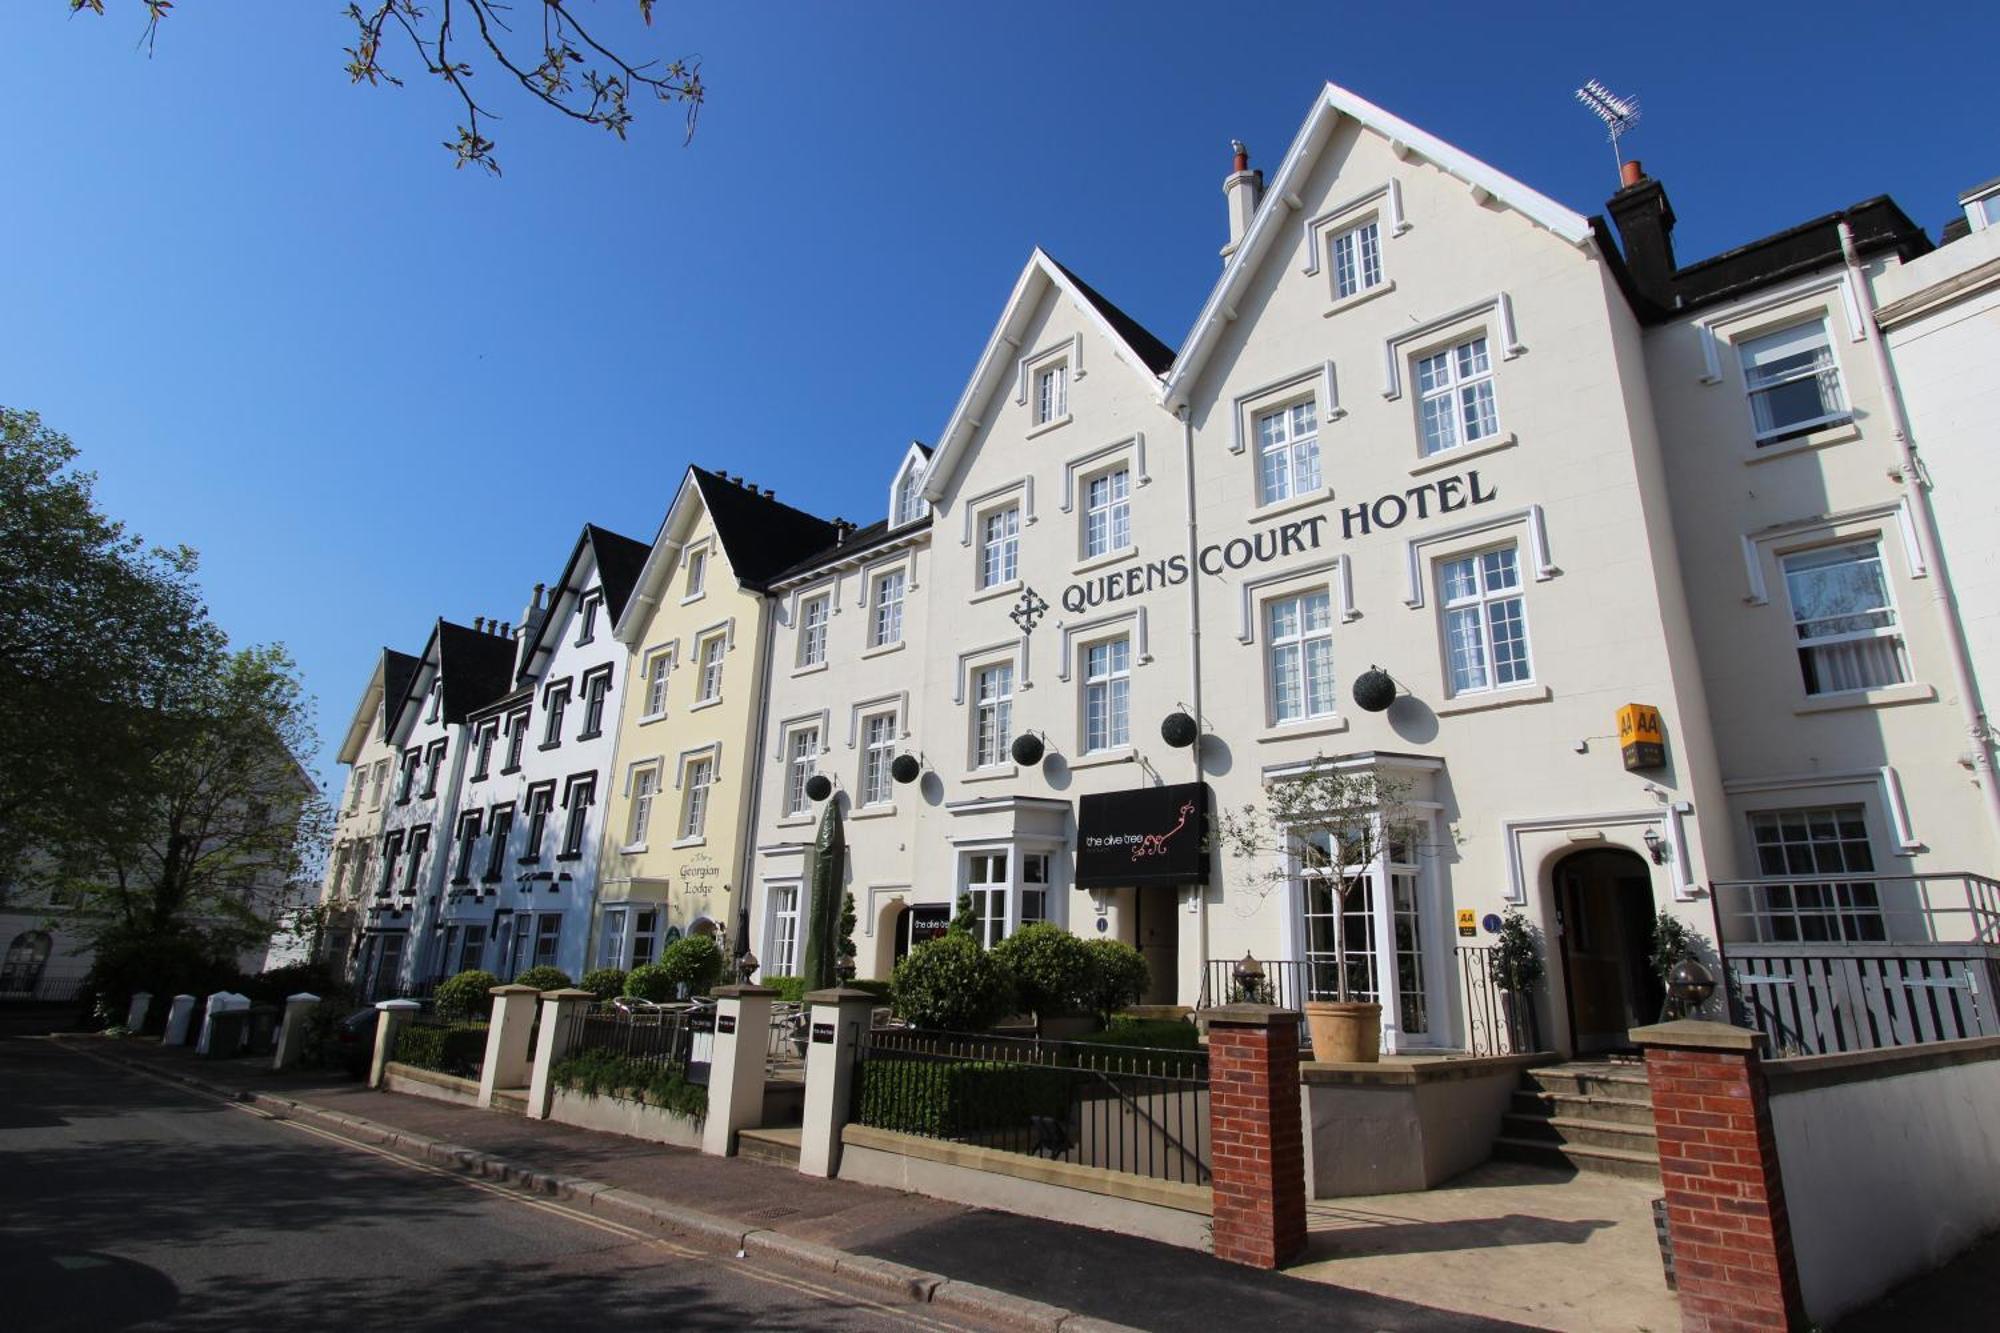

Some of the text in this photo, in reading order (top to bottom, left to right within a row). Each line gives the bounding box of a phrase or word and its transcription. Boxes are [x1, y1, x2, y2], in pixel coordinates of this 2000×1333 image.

[1062, 470, 1498, 614] QUEENS COURT HOTEL
[1637, 712, 1658, 734] AA
[1086, 834, 1144, 847] the olive tree
[680, 865, 720, 879] Georgian
[684, 882, 713, 897] Lodge
[1461, 914, 1473, 922] AA
